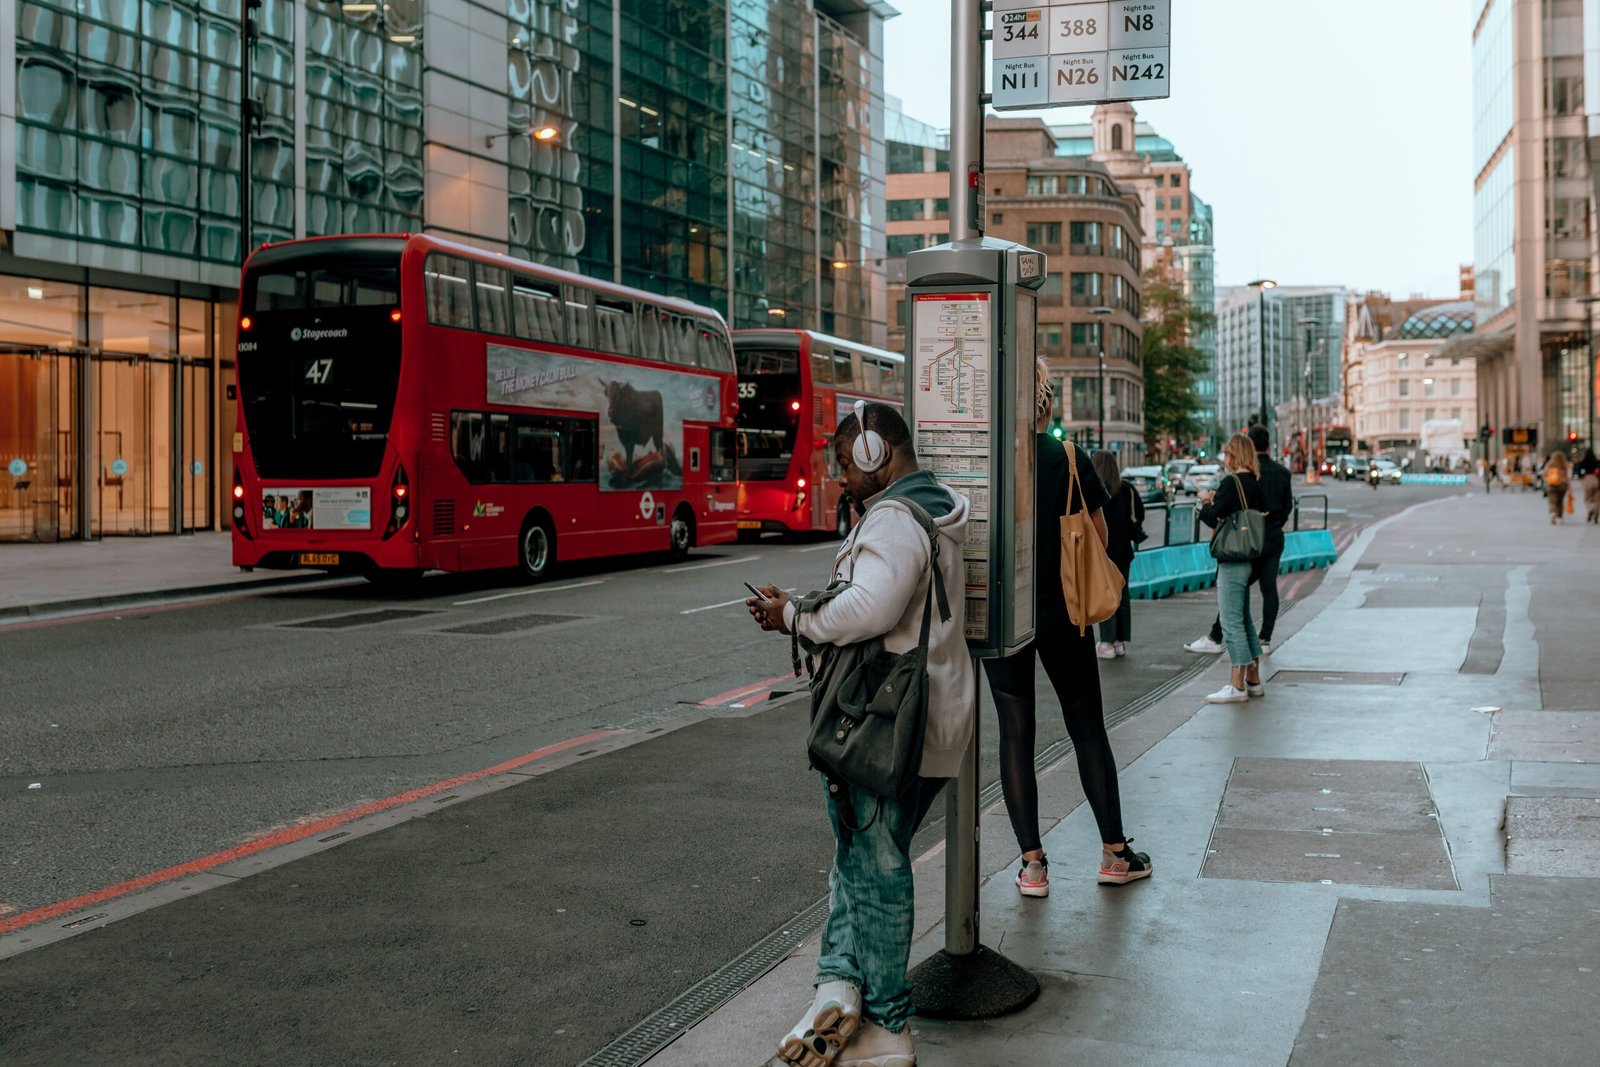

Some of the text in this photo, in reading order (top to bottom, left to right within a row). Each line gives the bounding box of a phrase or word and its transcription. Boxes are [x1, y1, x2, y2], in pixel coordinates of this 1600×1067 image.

[1060, 18, 1097, 37] 388
[1124, 14, 1154, 32] N8
[1003, 24, 1039, 42] 344
[1002, 71, 1038, 90] N11
[1057, 68, 1099, 86] N26
[1112, 63, 1164, 82] N242
[302, 328, 348, 340] Stagecoach
[305, 359, 333, 384] 47
[500, 379, 516, 395] THE
[560, 365, 576, 380] BULL
[738, 382, 756, 398] 35
